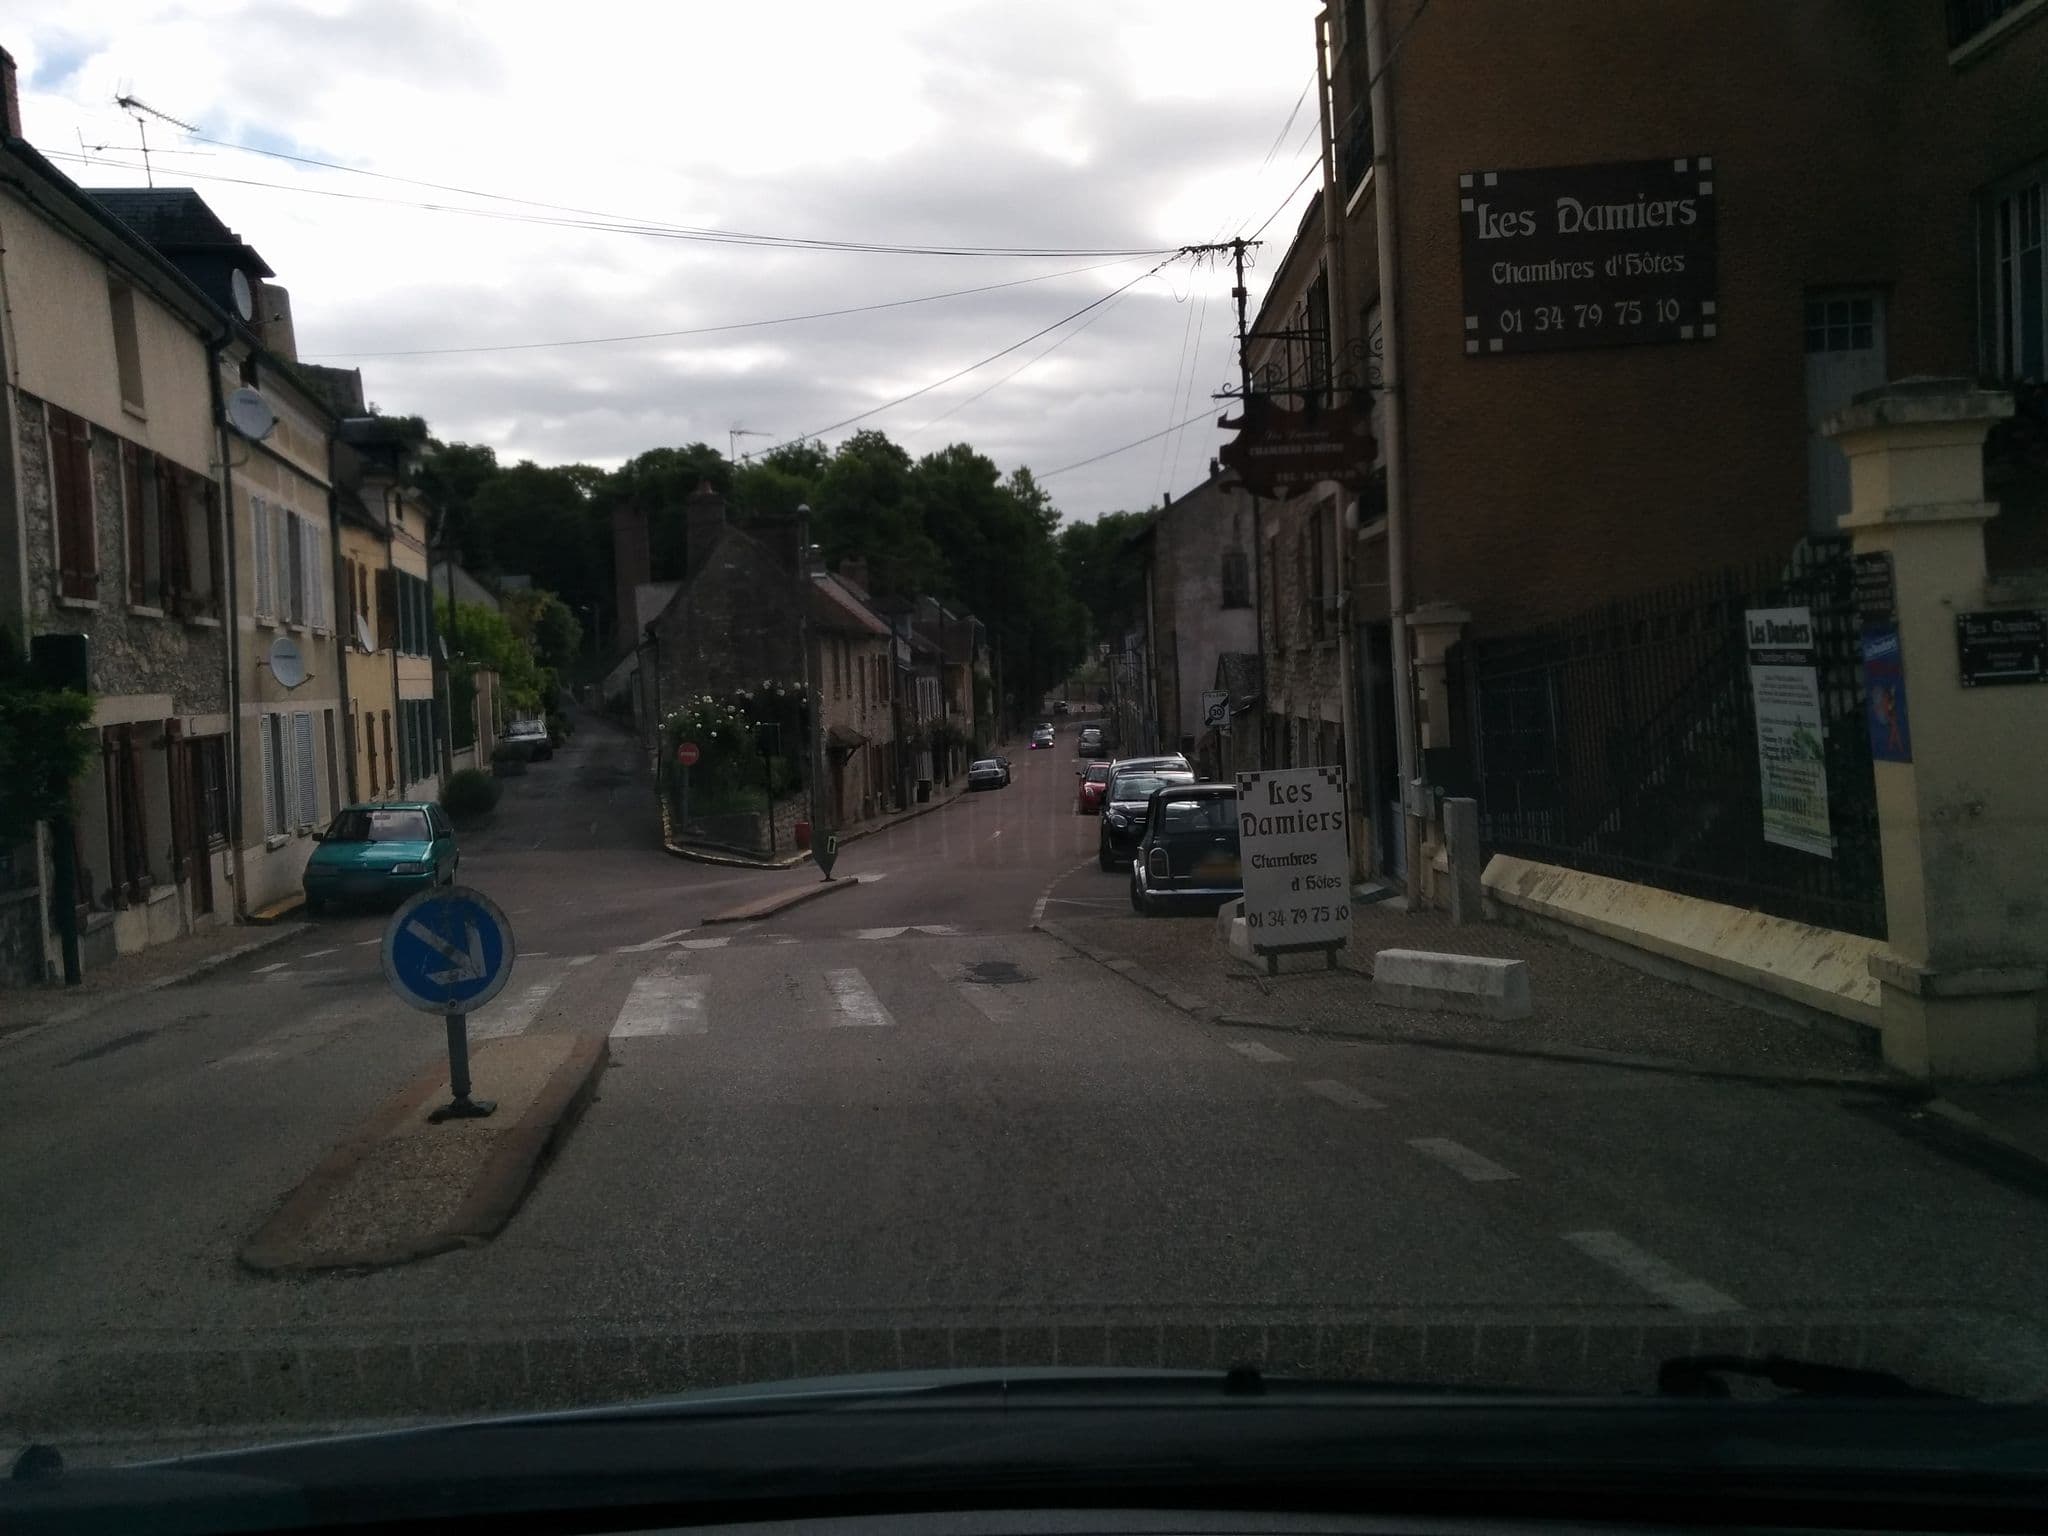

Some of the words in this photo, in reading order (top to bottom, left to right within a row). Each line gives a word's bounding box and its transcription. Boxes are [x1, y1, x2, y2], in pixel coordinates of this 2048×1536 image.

[1477, 202, 1537, 240] Les
[1556, 191, 1697, 234] Damiers
[1491, 258, 1595, 284] Chambres
[1500, 308, 1523, 334] 01
[1534, 305, 1565, 331] 34
[1574, 303, 1603, 329] 79
[1614, 300, 1643, 326] 75
[1655, 297, 1681, 323] 10
[1748, 620, 1765, 643] Les
[1268, 780, 1313, 806] Les
[1240, 809, 1343, 837] Damiers
[1251, 852, 1318, 869] Chambres
[1248, 912, 1264, 928] 01
[1268, 910, 1286, 927] 34
[1290, 908, 1308, 924] 79
[1311, 906, 1330, 922] 75
[1335, 904, 1350, 921] 10
